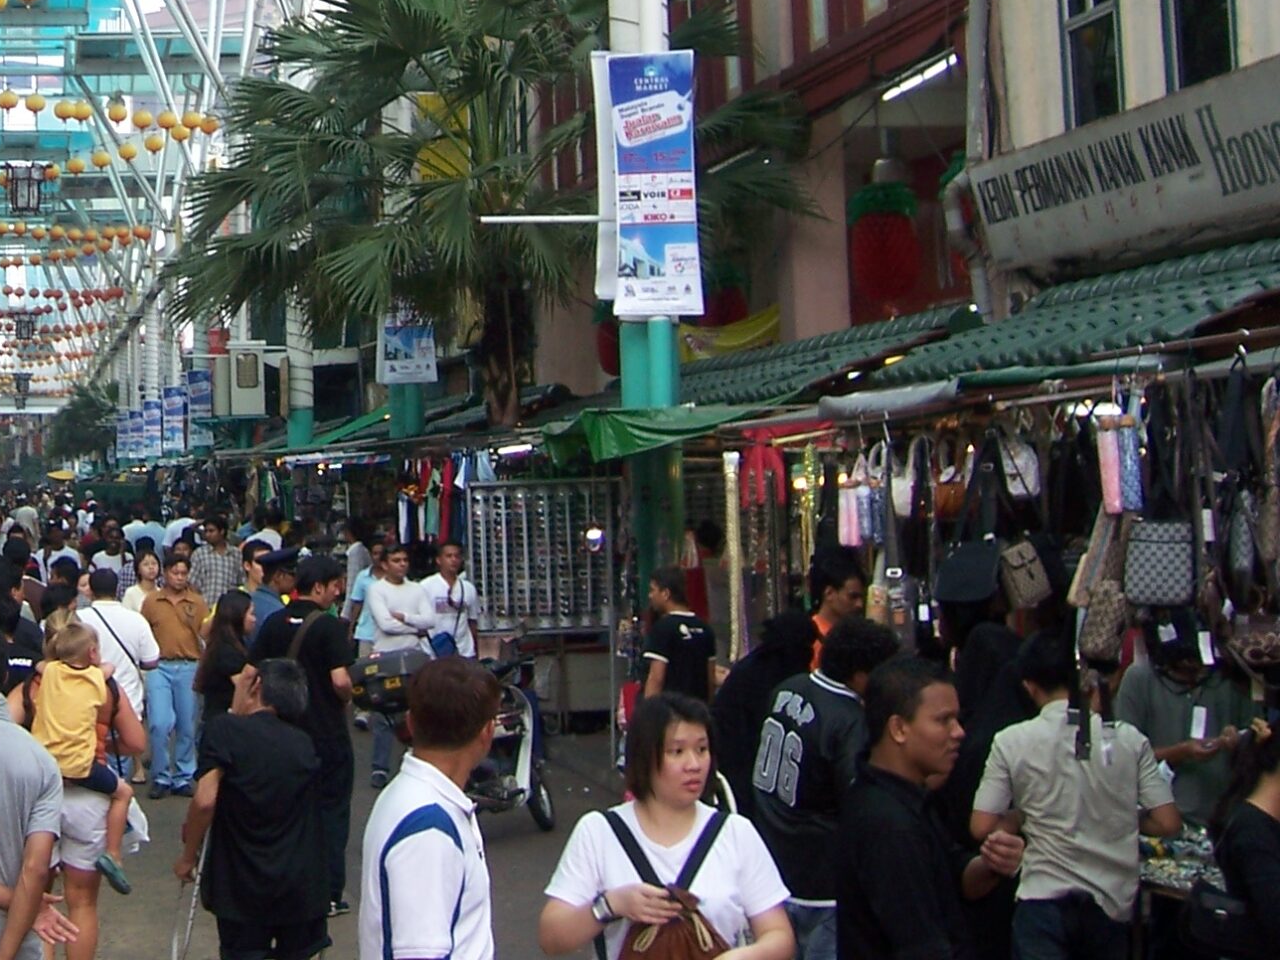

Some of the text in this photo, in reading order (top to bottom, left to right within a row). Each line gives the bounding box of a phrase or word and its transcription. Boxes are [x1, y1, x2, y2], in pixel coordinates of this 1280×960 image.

[635, 83, 669, 91] MARKET
[1087, 131, 1146, 193] KANAK
[1137, 113, 1201, 179] KANAK
[643, 213, 667, 221] KIKO
[752, 716, 803, 808] 06
